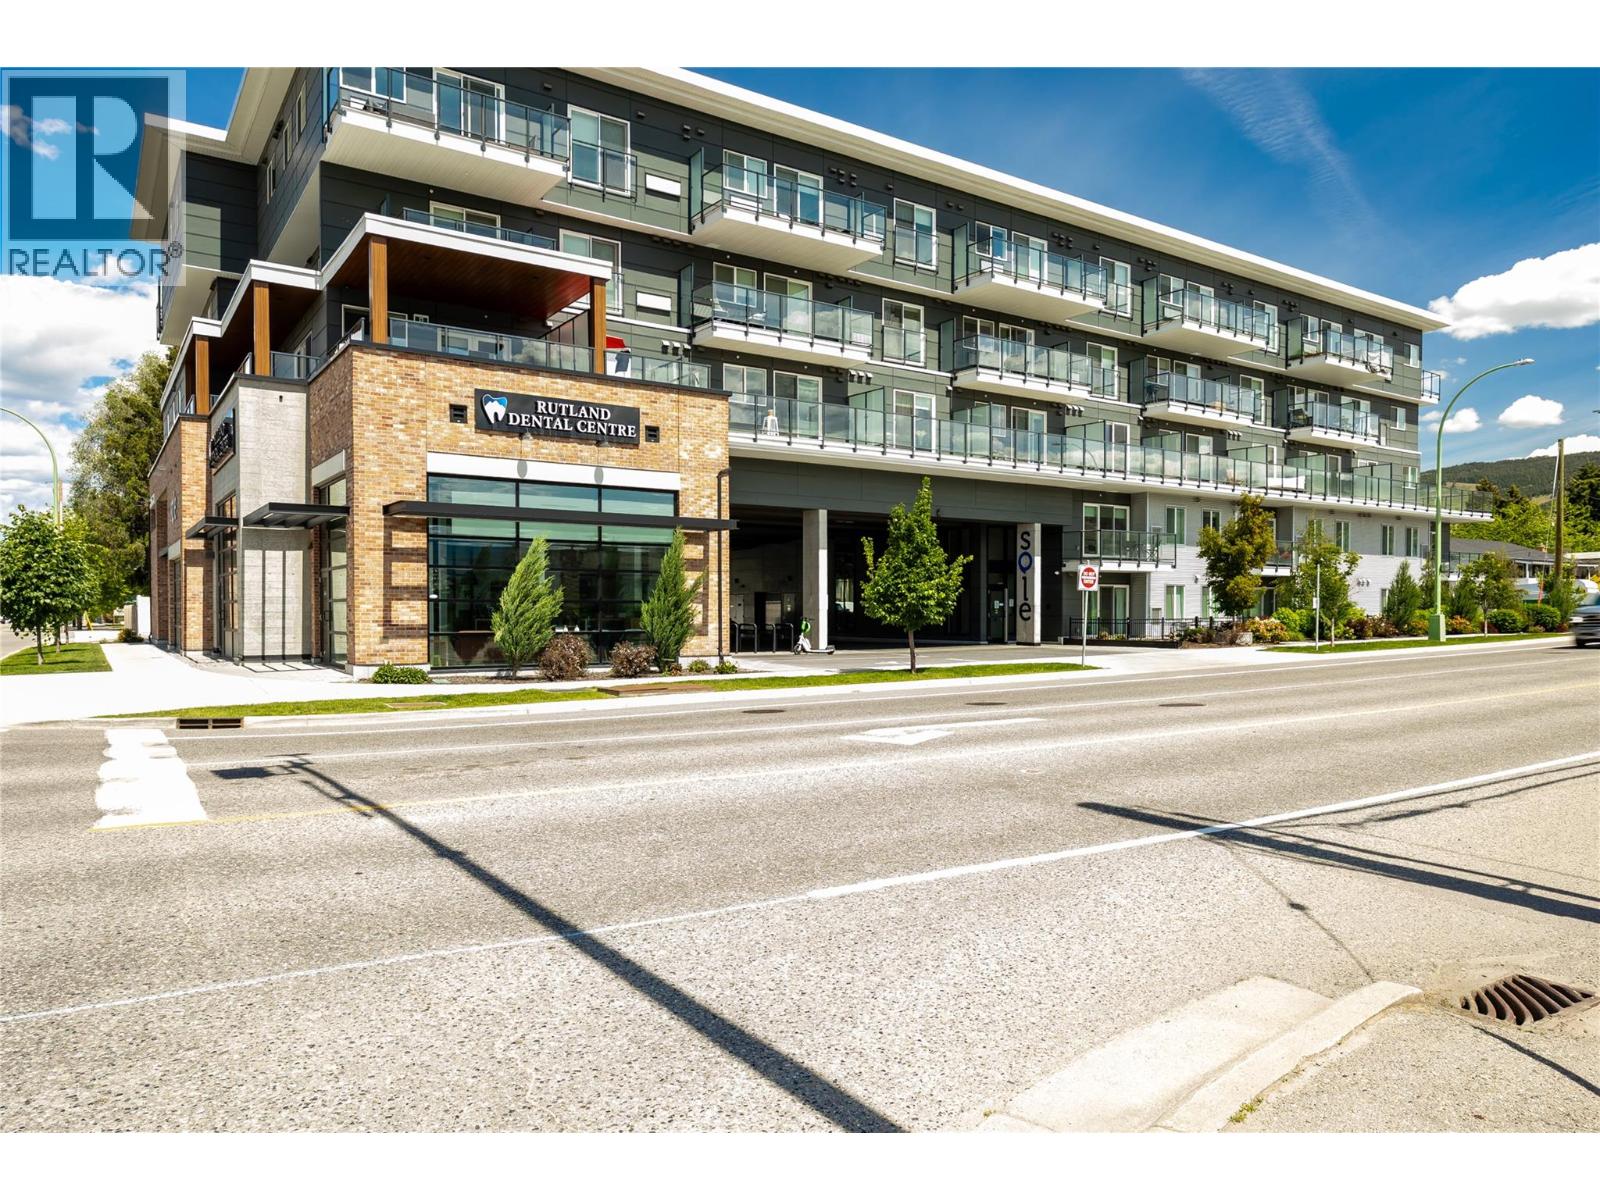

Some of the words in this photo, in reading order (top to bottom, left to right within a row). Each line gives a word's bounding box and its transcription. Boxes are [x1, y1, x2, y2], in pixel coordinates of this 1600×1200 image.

[536, 399, 611, 420] RUTLAND
[508, 412, 574, 432] DENTAL
[576, 419, 637, 438] CENTRE
